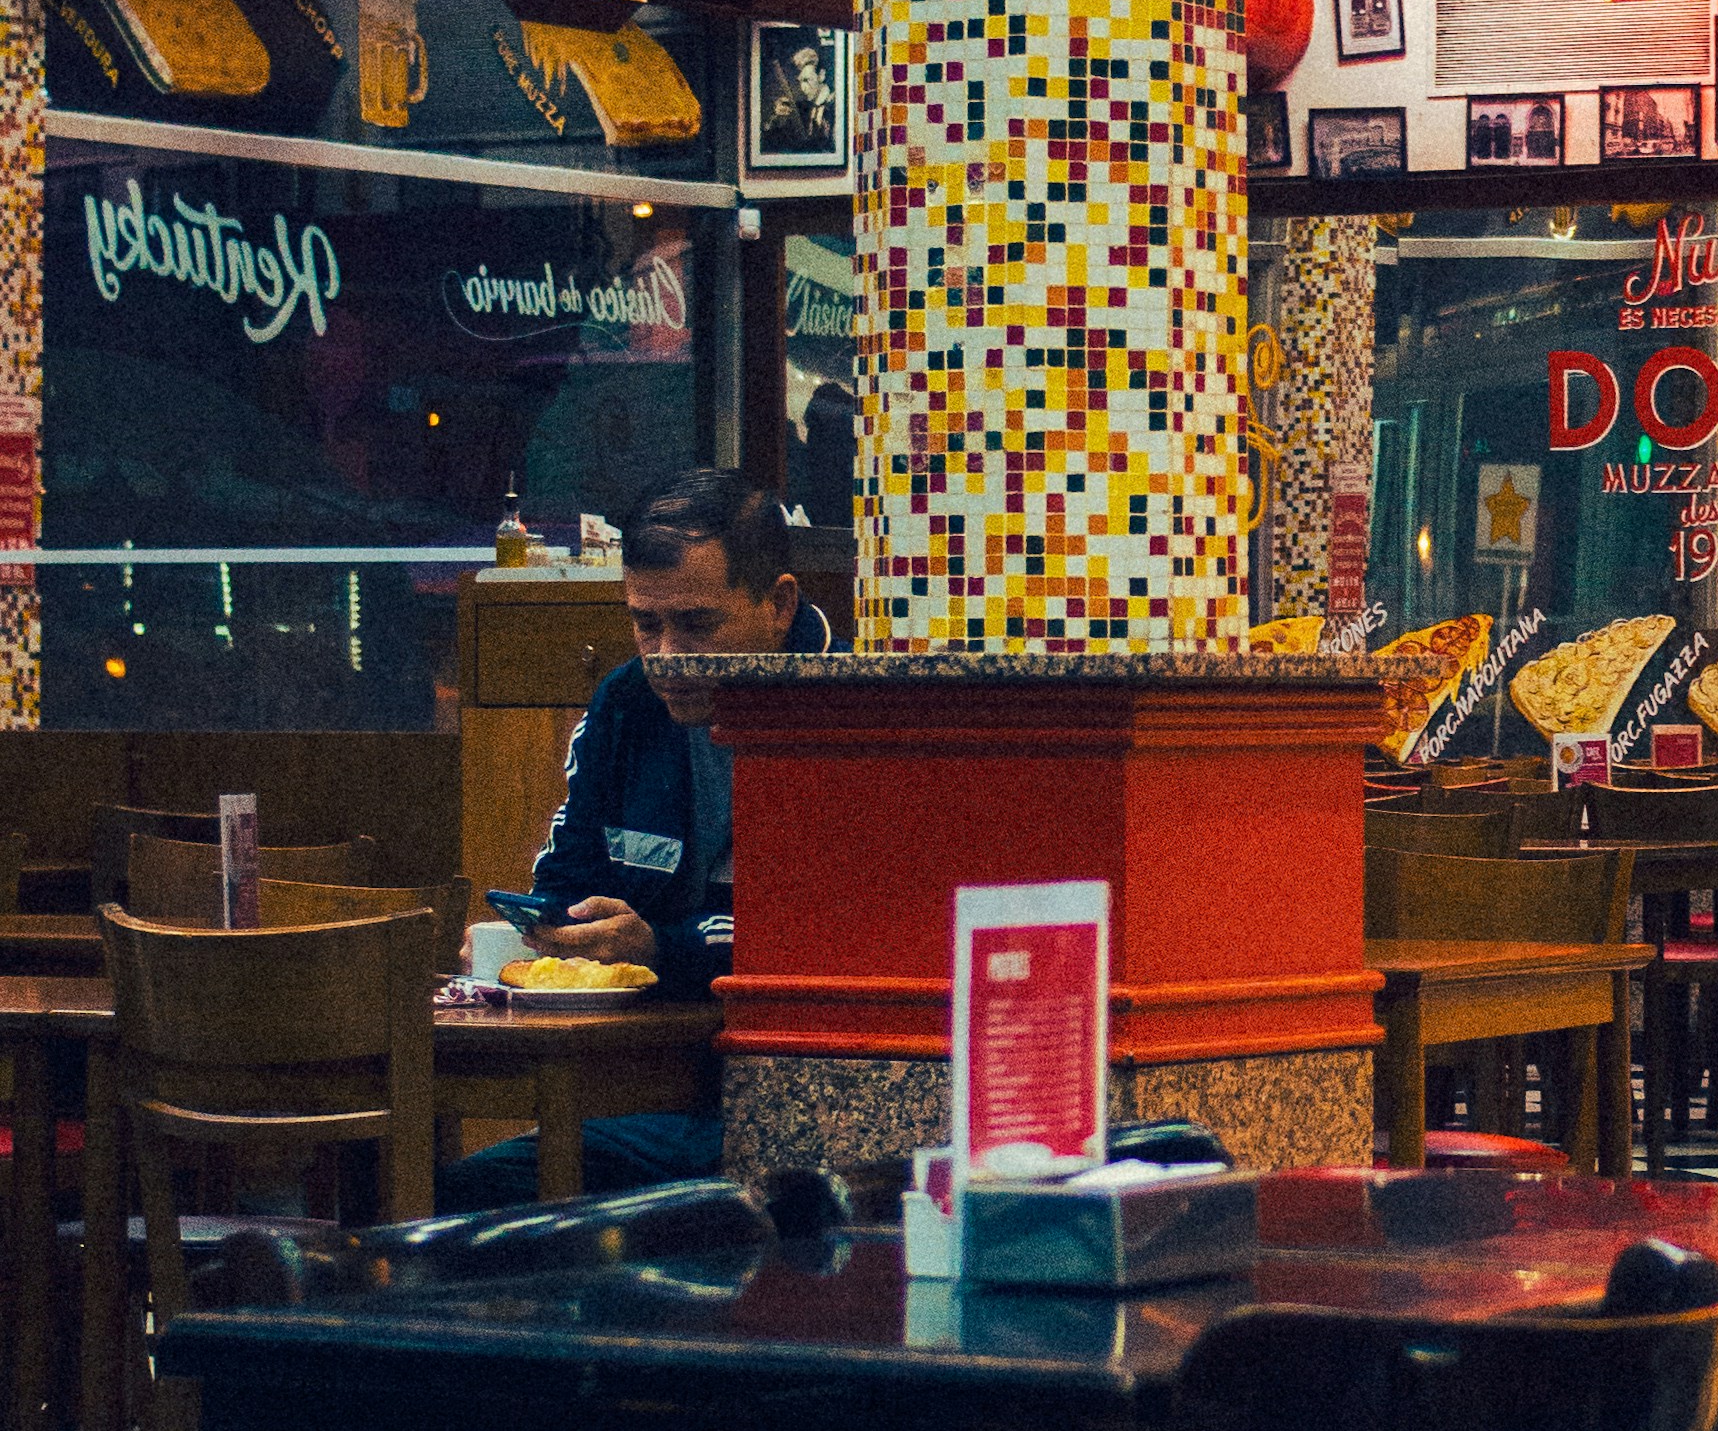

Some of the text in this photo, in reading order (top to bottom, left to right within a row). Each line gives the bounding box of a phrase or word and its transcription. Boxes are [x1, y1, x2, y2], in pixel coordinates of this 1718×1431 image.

[1618, 308, 1645, 330] ES
[1317, 601, 1388, 655] RONES
[1611, 631, 1709, 762] ORC.FUGAZZA
